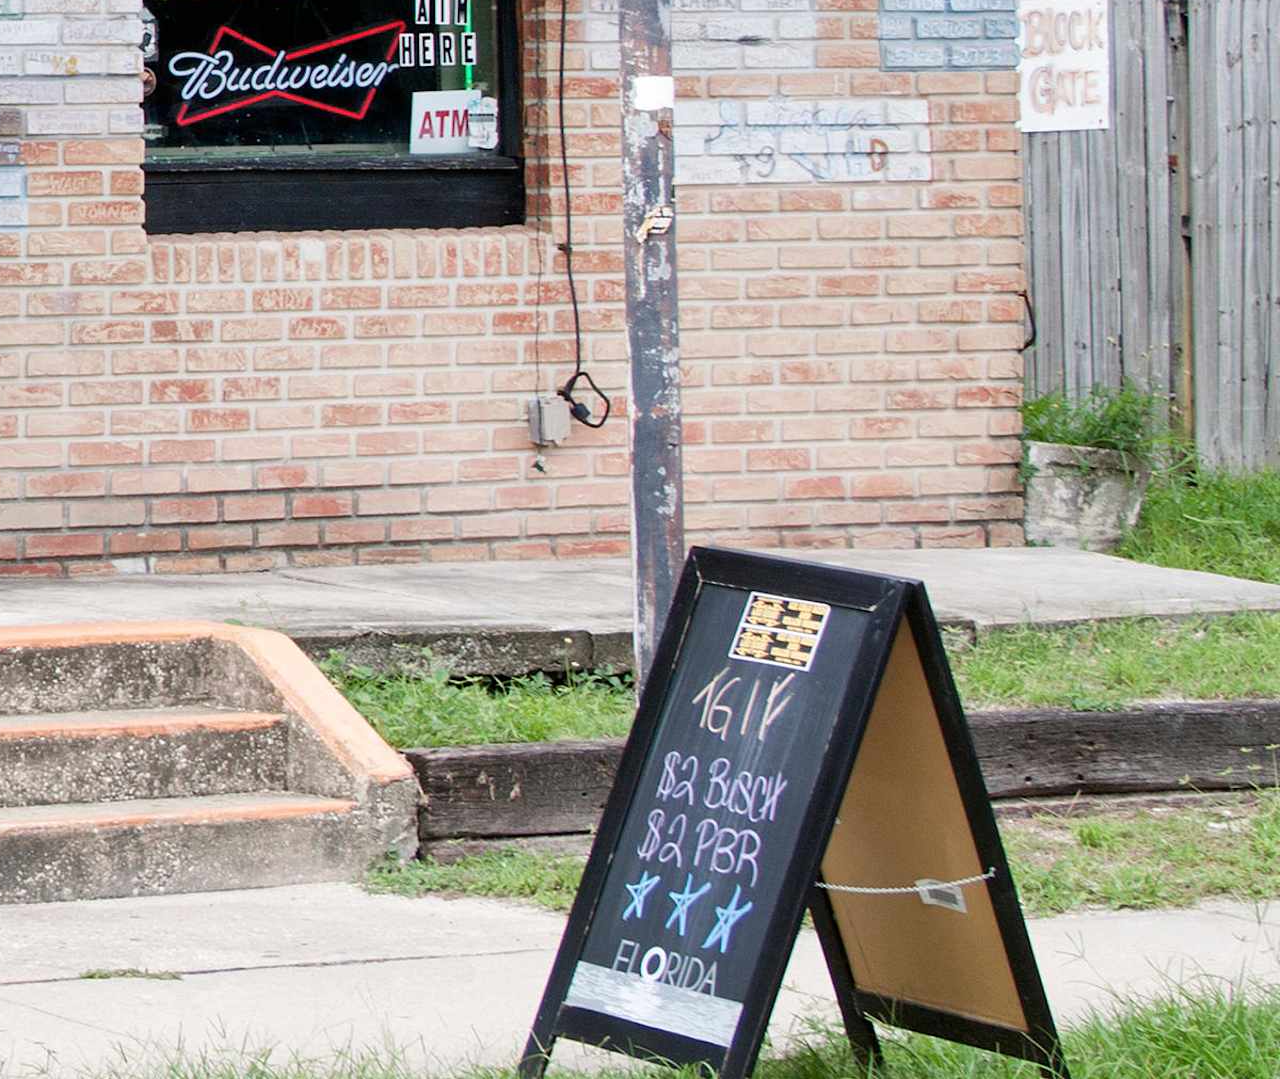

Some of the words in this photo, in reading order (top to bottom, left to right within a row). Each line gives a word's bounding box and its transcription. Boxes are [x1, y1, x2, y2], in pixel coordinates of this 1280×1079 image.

[168, 50, 400, 101] Budweiser
[399, 33, 477, 66] HERE
[1032, 64, 1102, 116] GATE
[418, 108, 469, 139] ATM
[657, 751, 700, 808] $2
[638, 808, 686, 869] $2
[696, 818, 762, 885] PBR
[612, 938, 720, 995] FLORIDA
